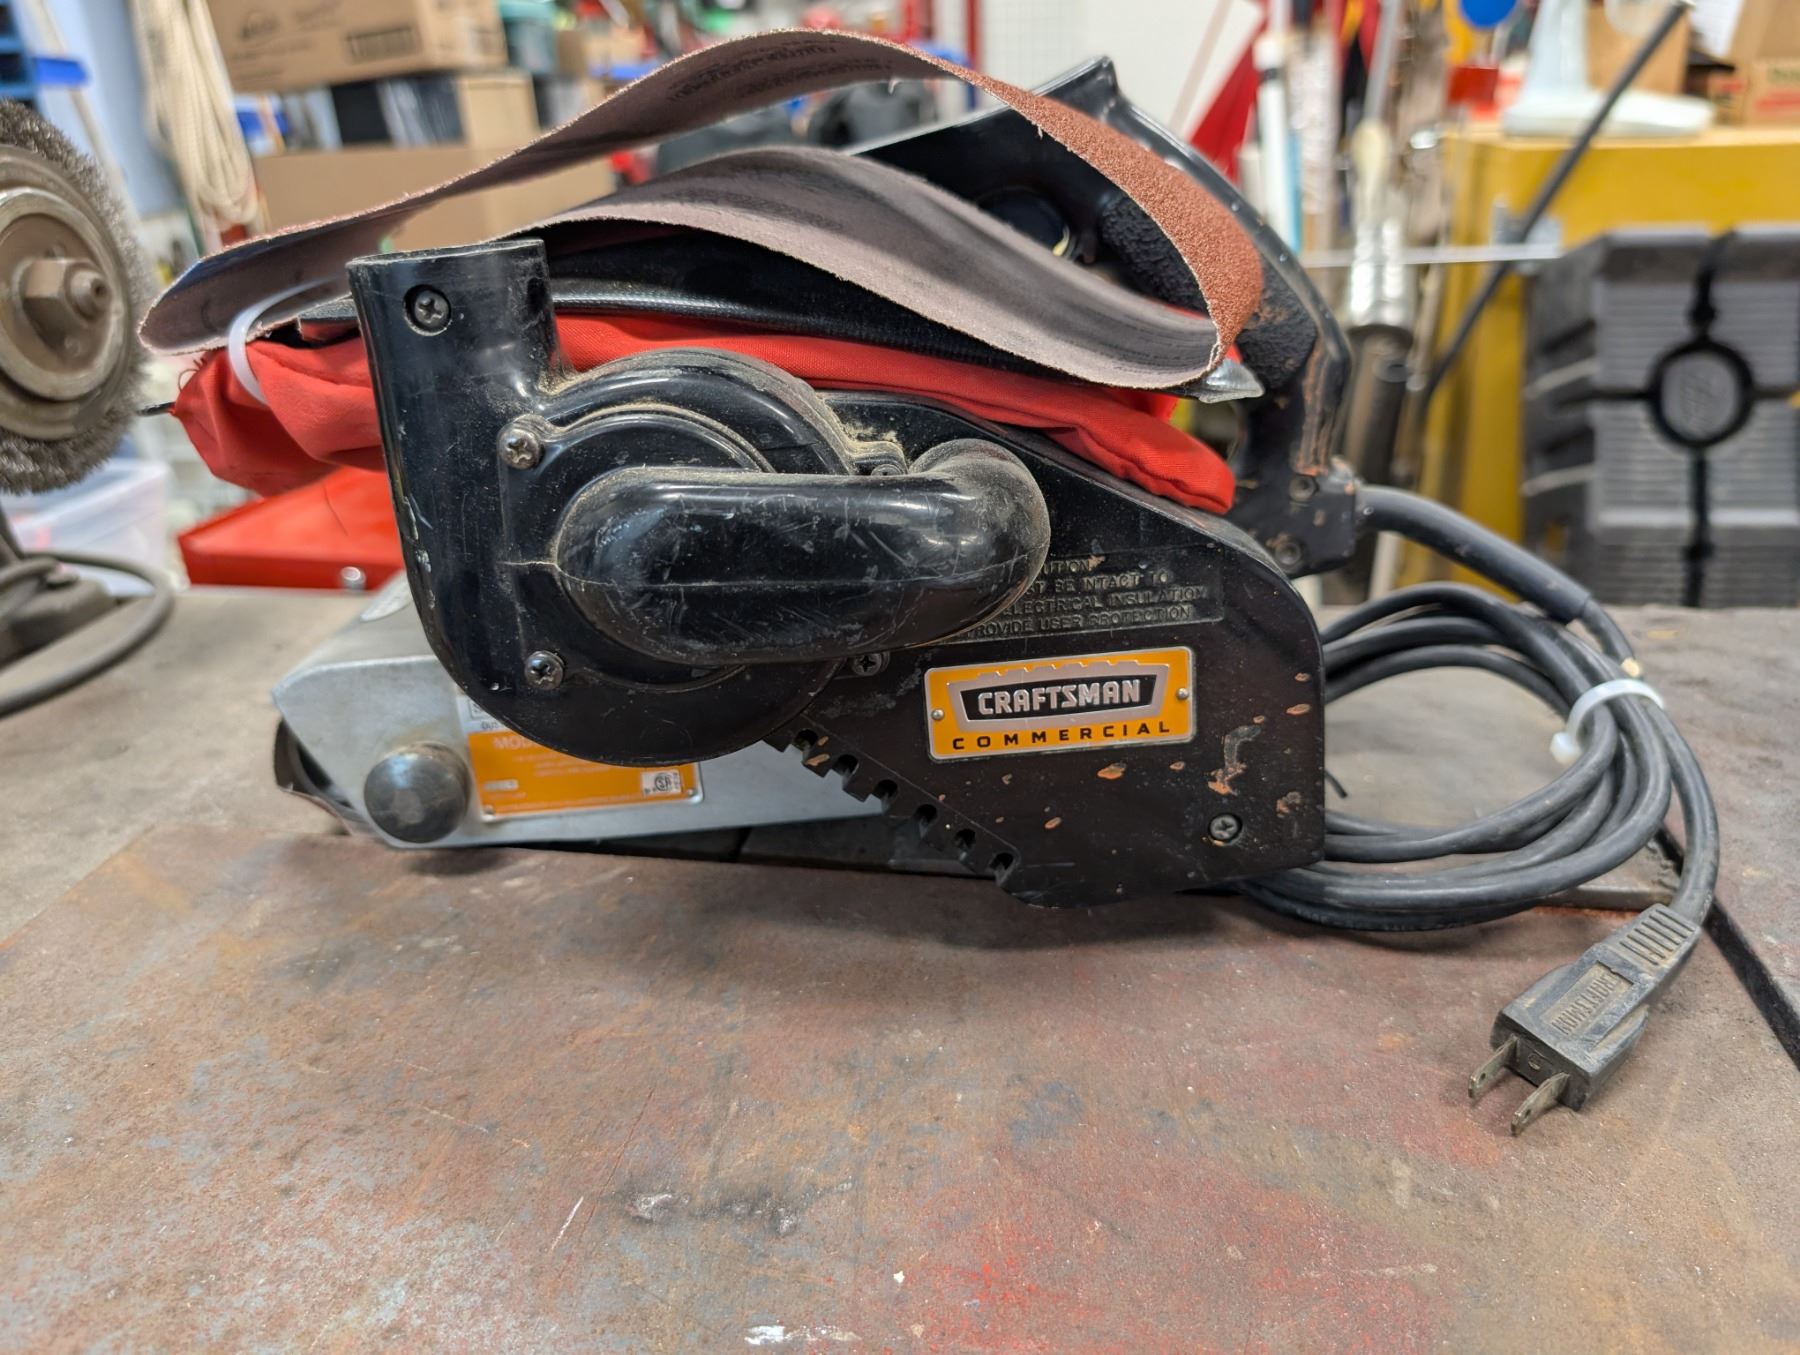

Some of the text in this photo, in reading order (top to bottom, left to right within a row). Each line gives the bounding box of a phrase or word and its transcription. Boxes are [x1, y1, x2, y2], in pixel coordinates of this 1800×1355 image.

[1042, 559, 1089, 575] UTION
[1040, 614, 1083, 631] USER
[1089, 604, 1192, 627] PROTECTION
[977, 679, 1141, 716] CRAFTSMAN
[952, 721, 1170, 749] COMMERCIAL
